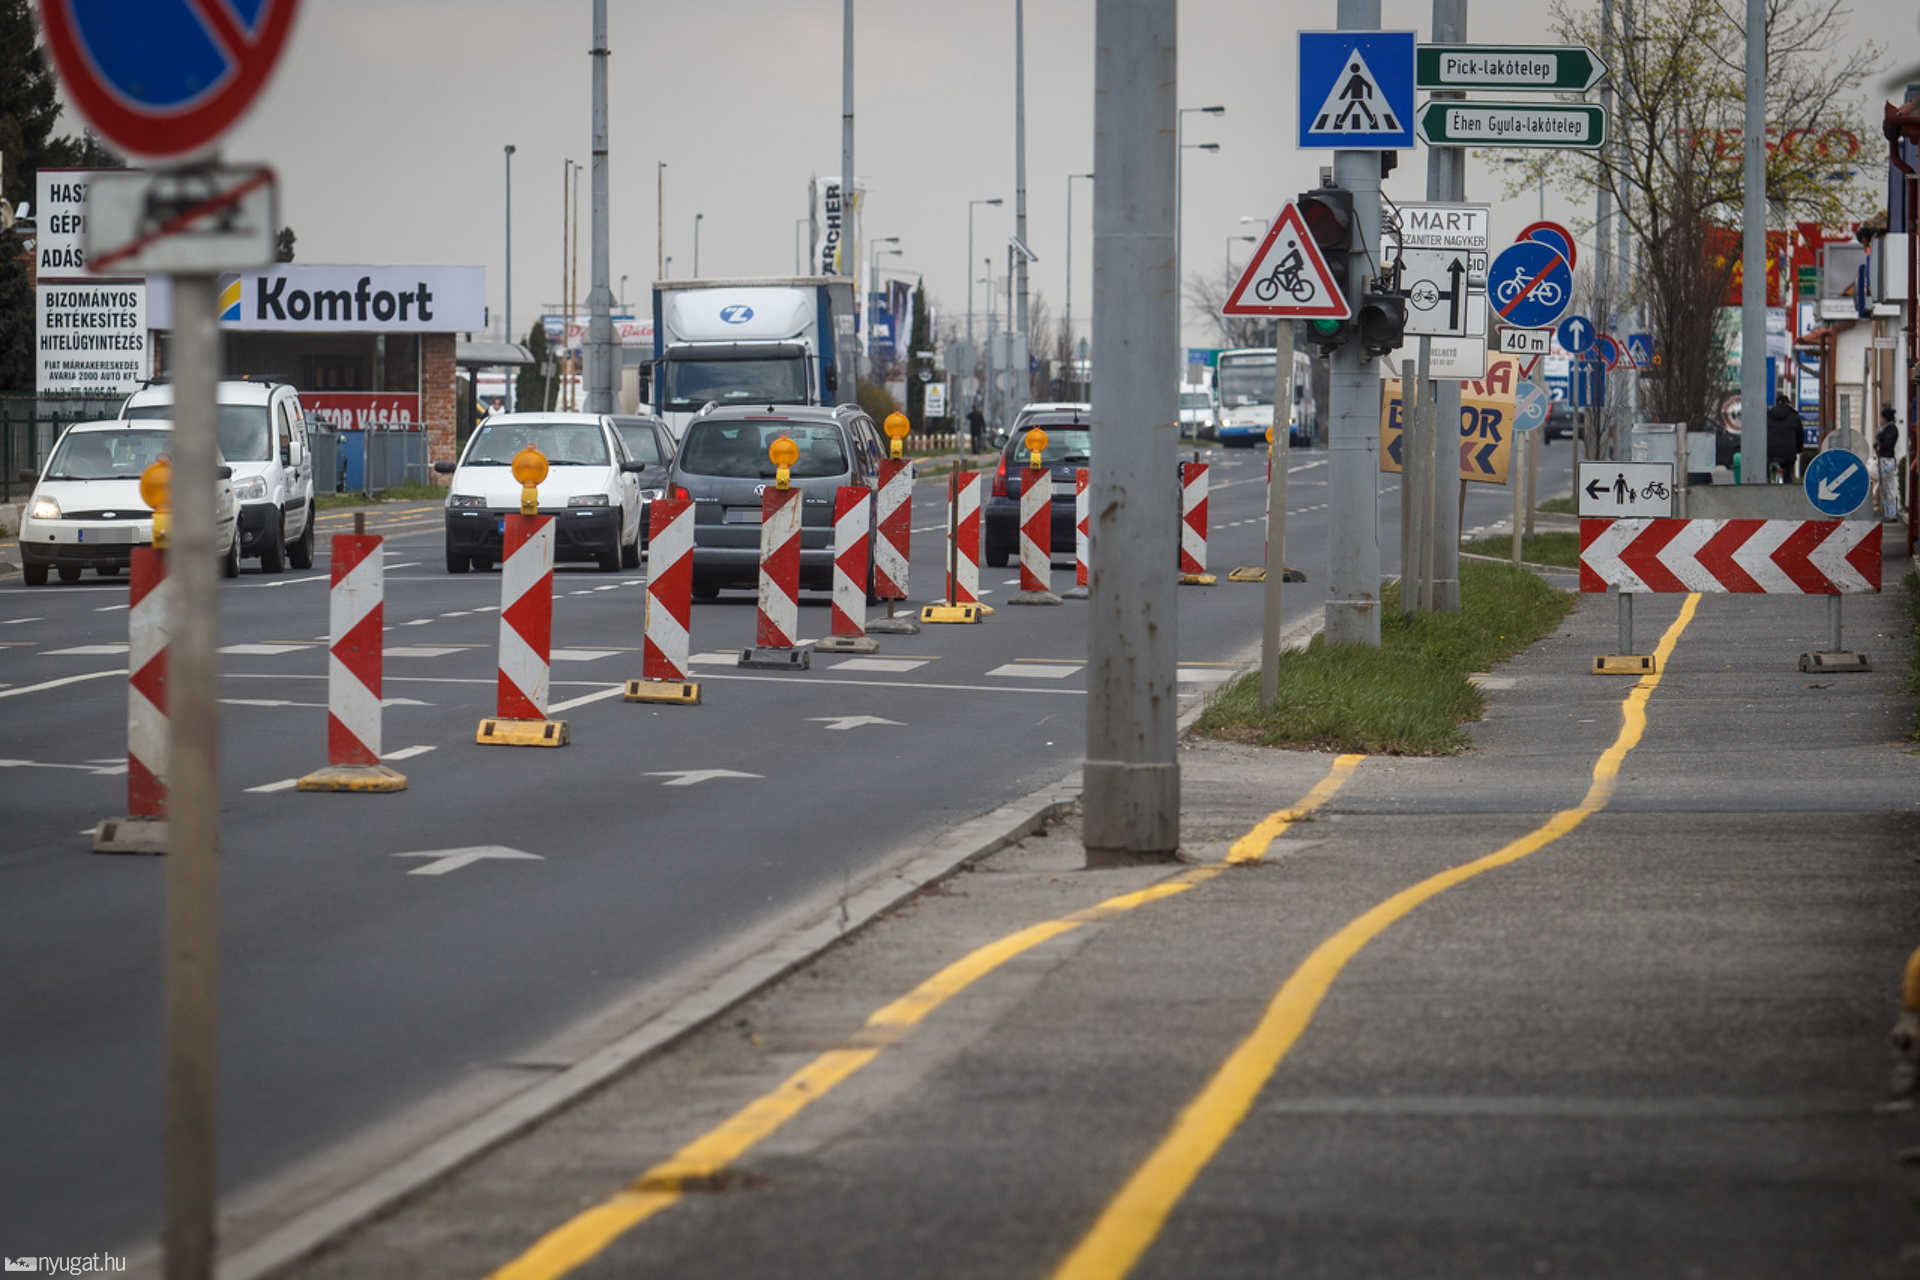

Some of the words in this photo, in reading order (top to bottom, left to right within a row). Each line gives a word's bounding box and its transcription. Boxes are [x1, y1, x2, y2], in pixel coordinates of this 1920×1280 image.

[1447, 59, 1550, 79] Pick-lakótelep
[1453, 112, 1481, 132] Éhen
[1488, 117, 1582, 136] Gyula-lakótelep
[1410, 211, 1478, 231] MART
[1443, 235, 1486, 247] NAGYKER
[46, 288, 137, 308] BIZOMÁNYOS
[256, 276, 433, 322] Komfort
[46, 309, 137, 328] ÉRTÉKESÍTÉS
[1507, 334, 1527, 350] 40
[1531, 338, 1544, 350] m
[44, 361, 60, 370] FIAT
[79, 372, 98, 381] 2000
